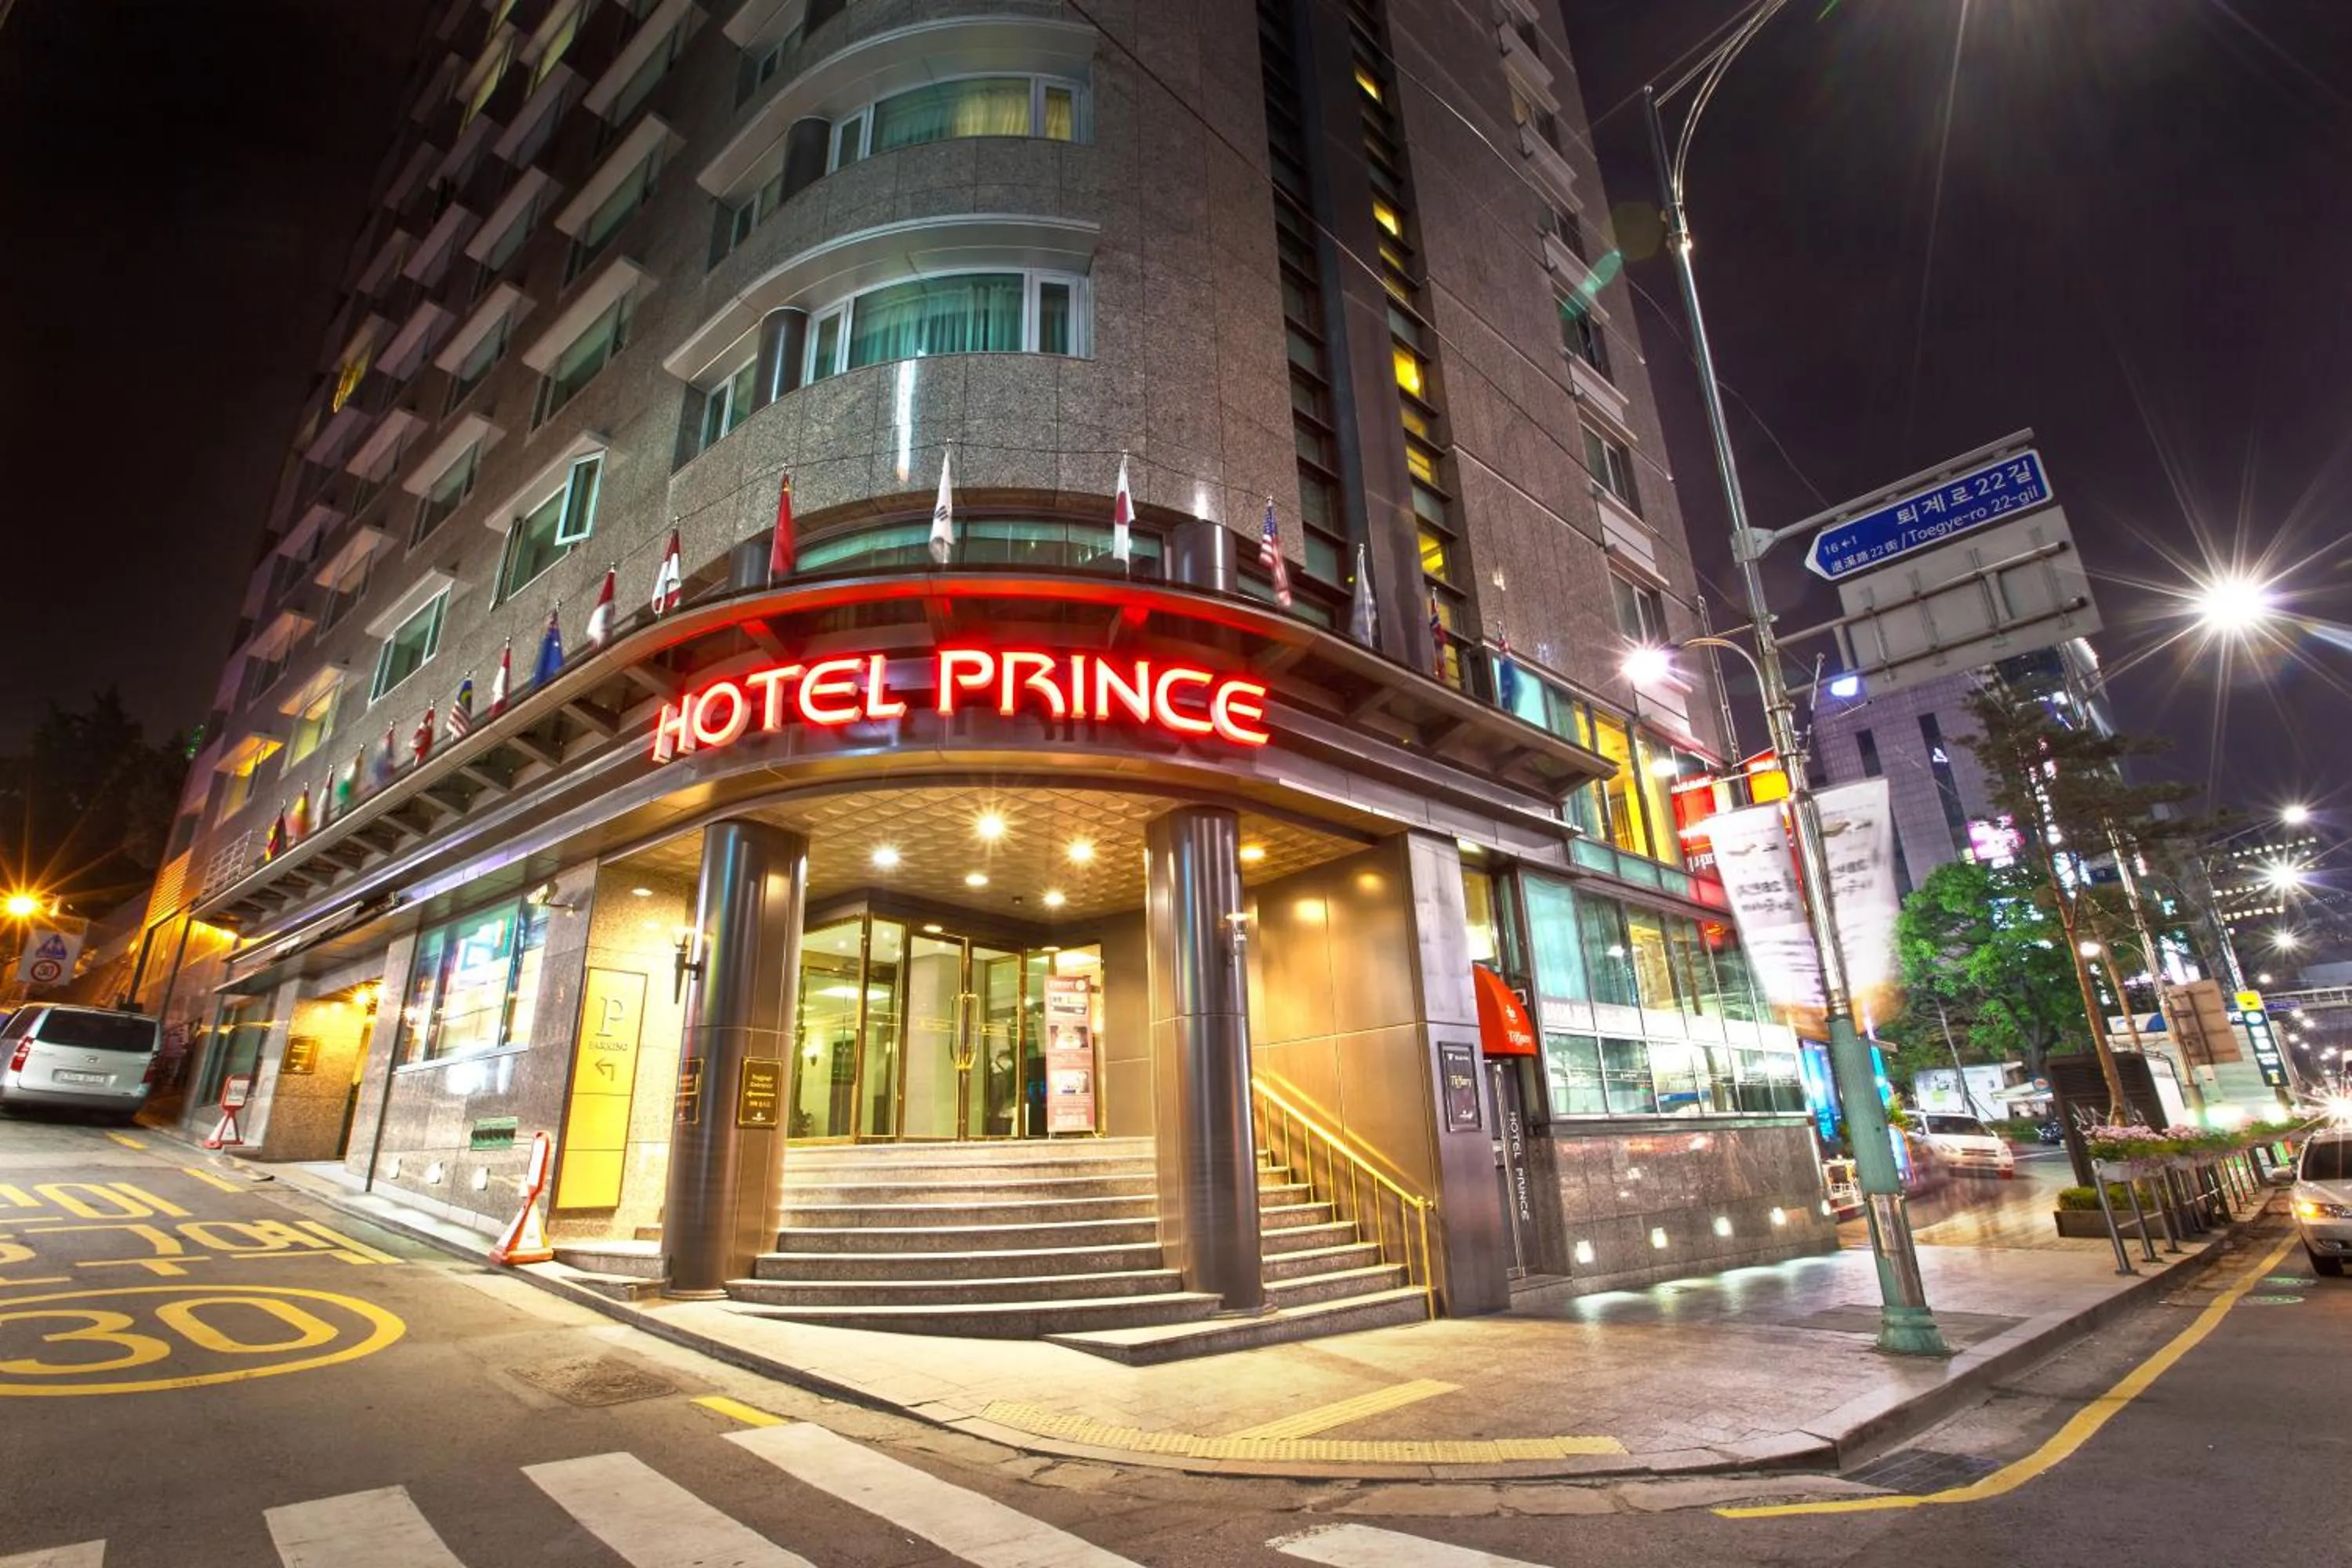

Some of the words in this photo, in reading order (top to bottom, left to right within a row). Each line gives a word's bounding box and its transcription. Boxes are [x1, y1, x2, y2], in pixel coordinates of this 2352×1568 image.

[1991, 486, 2039, 514] 22-gil
[653, 655, 906, 764] HOTEL
[938, 650, 1271, 744] PRINCE
[594, 996, 625, 1037] P
[1509, 1111, 1522, 1160] HOTEL
[1515, 1167, 1530, 1221] PRINCE
[0, 1296, 340, 1375] 30
